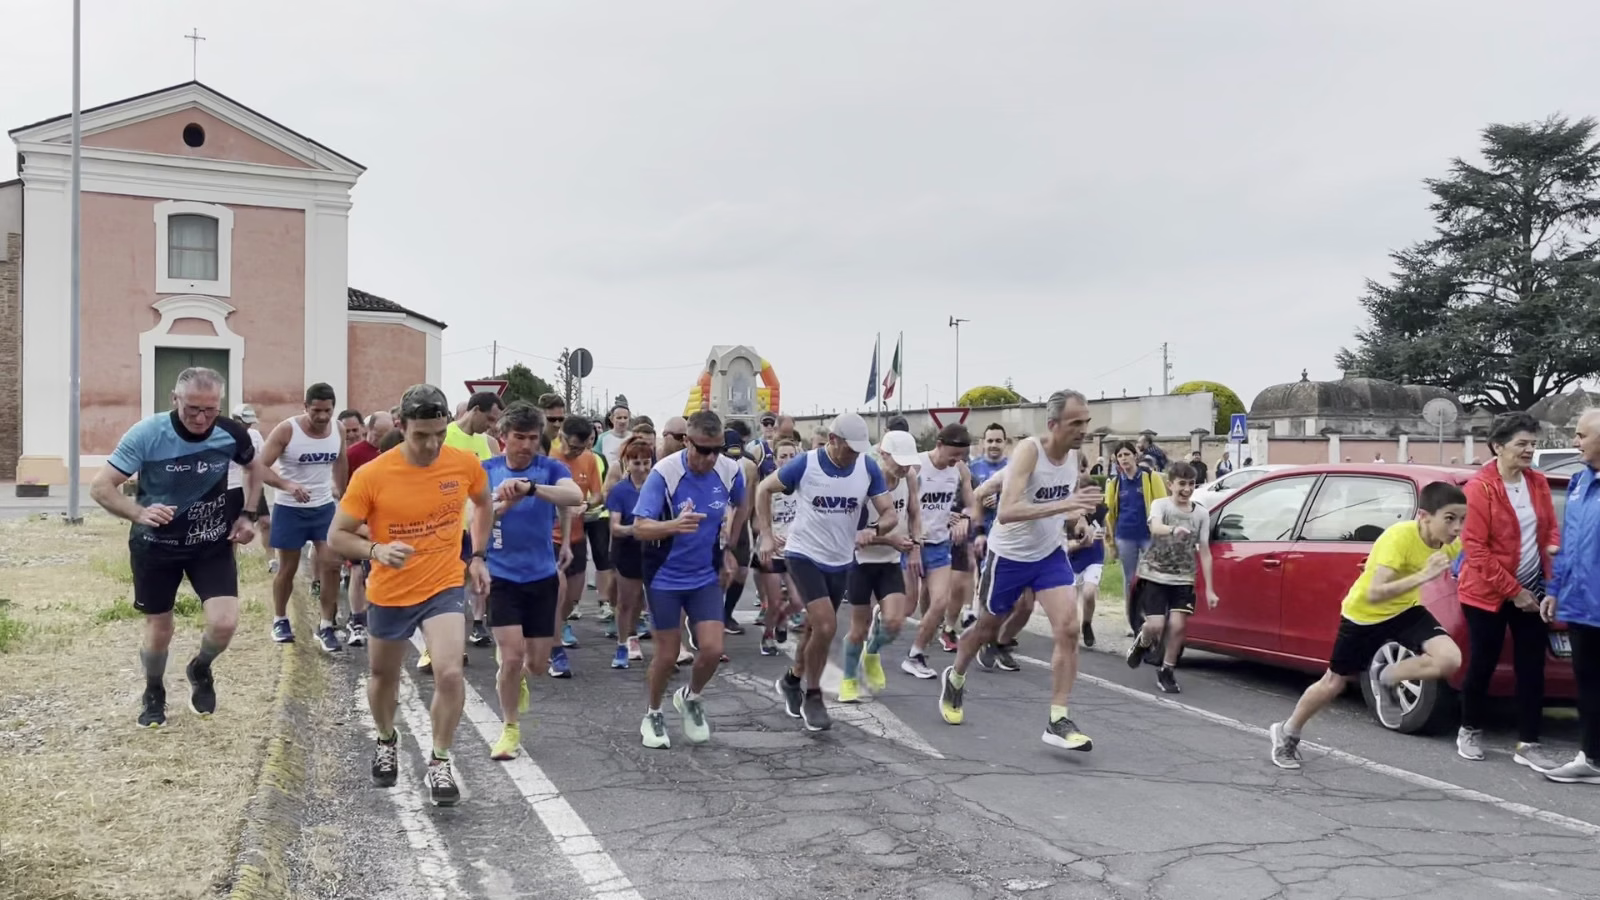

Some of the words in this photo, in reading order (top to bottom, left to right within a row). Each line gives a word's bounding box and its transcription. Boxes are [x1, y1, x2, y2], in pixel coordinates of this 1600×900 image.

[298, 452, 337, 463] AVIS
[165, 464, 192, 472] CMP
[920, 491, 954, 503] AVIS
[1034, 484, 1070, 499] AVIS
[811, 495, 859, 509] AVIS
